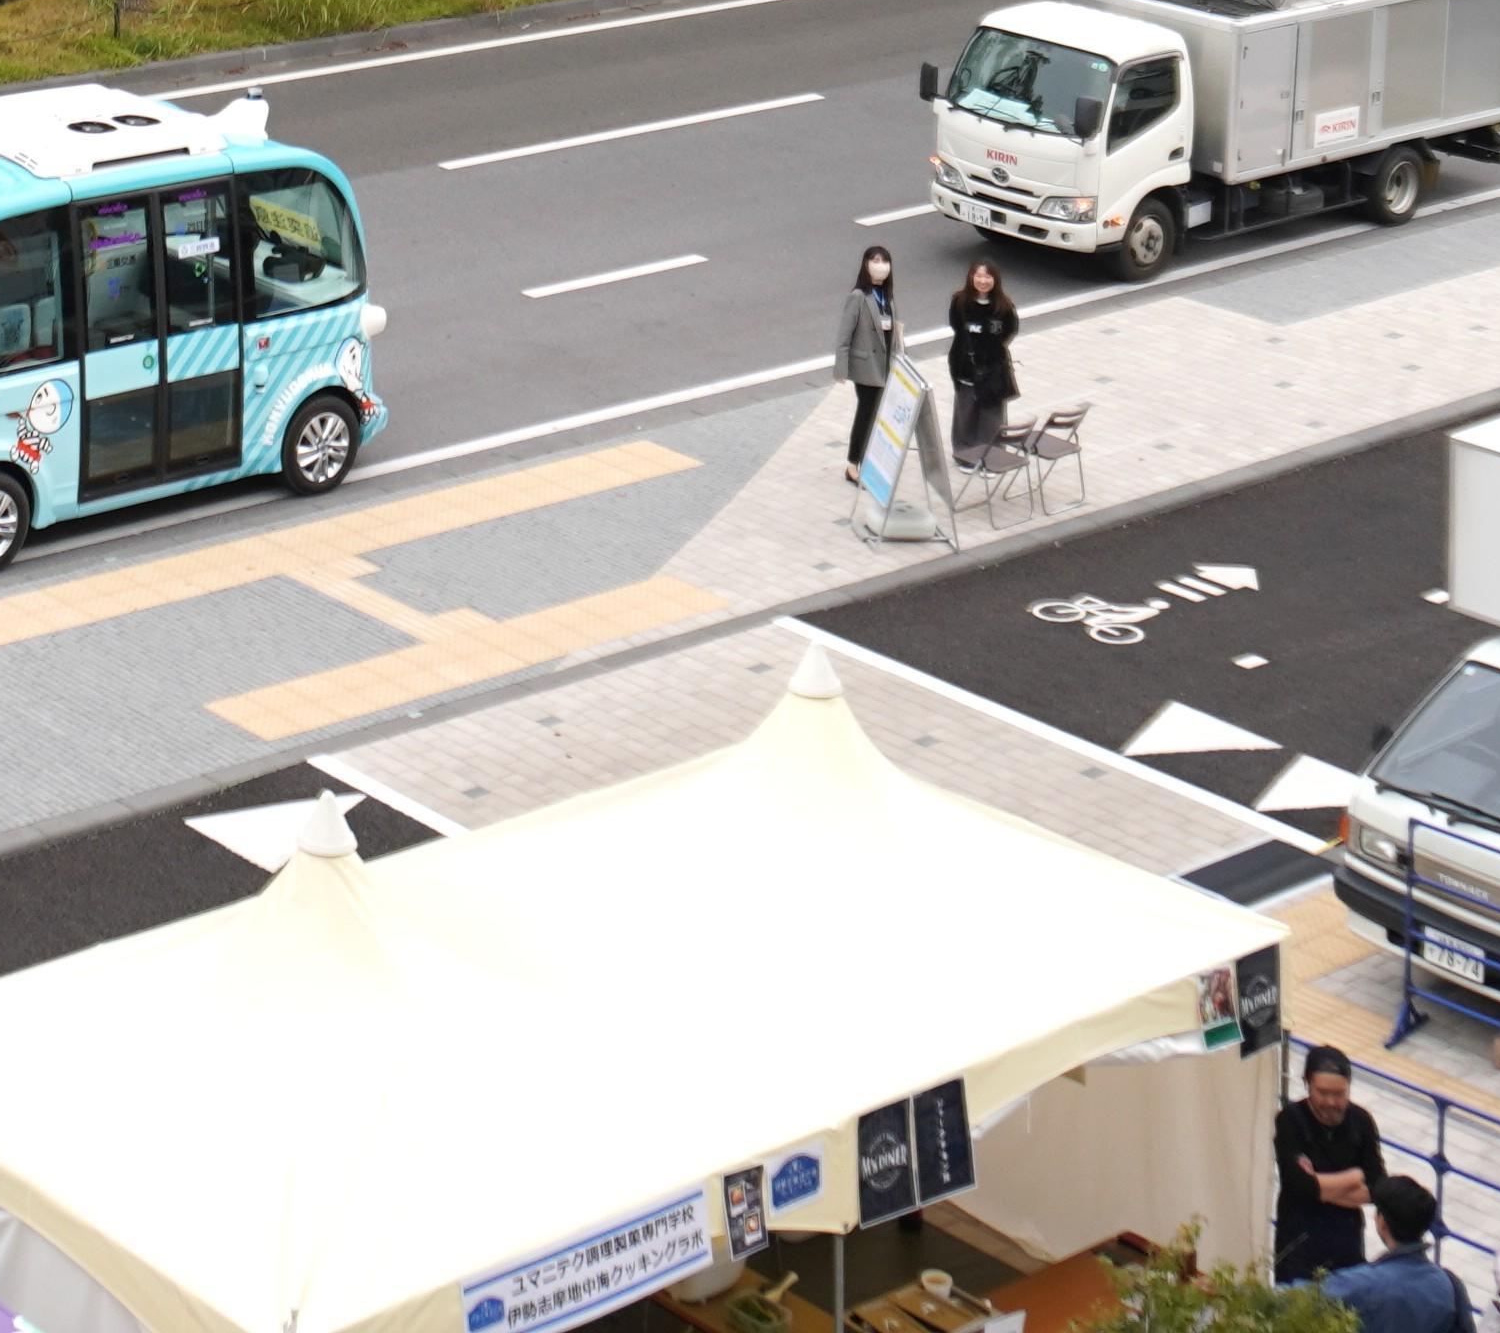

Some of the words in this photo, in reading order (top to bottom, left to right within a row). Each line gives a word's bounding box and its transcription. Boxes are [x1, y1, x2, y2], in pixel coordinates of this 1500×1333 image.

[986, 148, 1018, 166] KIRIN
[879, 1142, 908, 1174] DINER
[507, 1228, 705, 1329] 伊勢志摩地中海クッキングラボ
[511, 1204, 695, 1297] ユマニテク調理製菓専門学校
